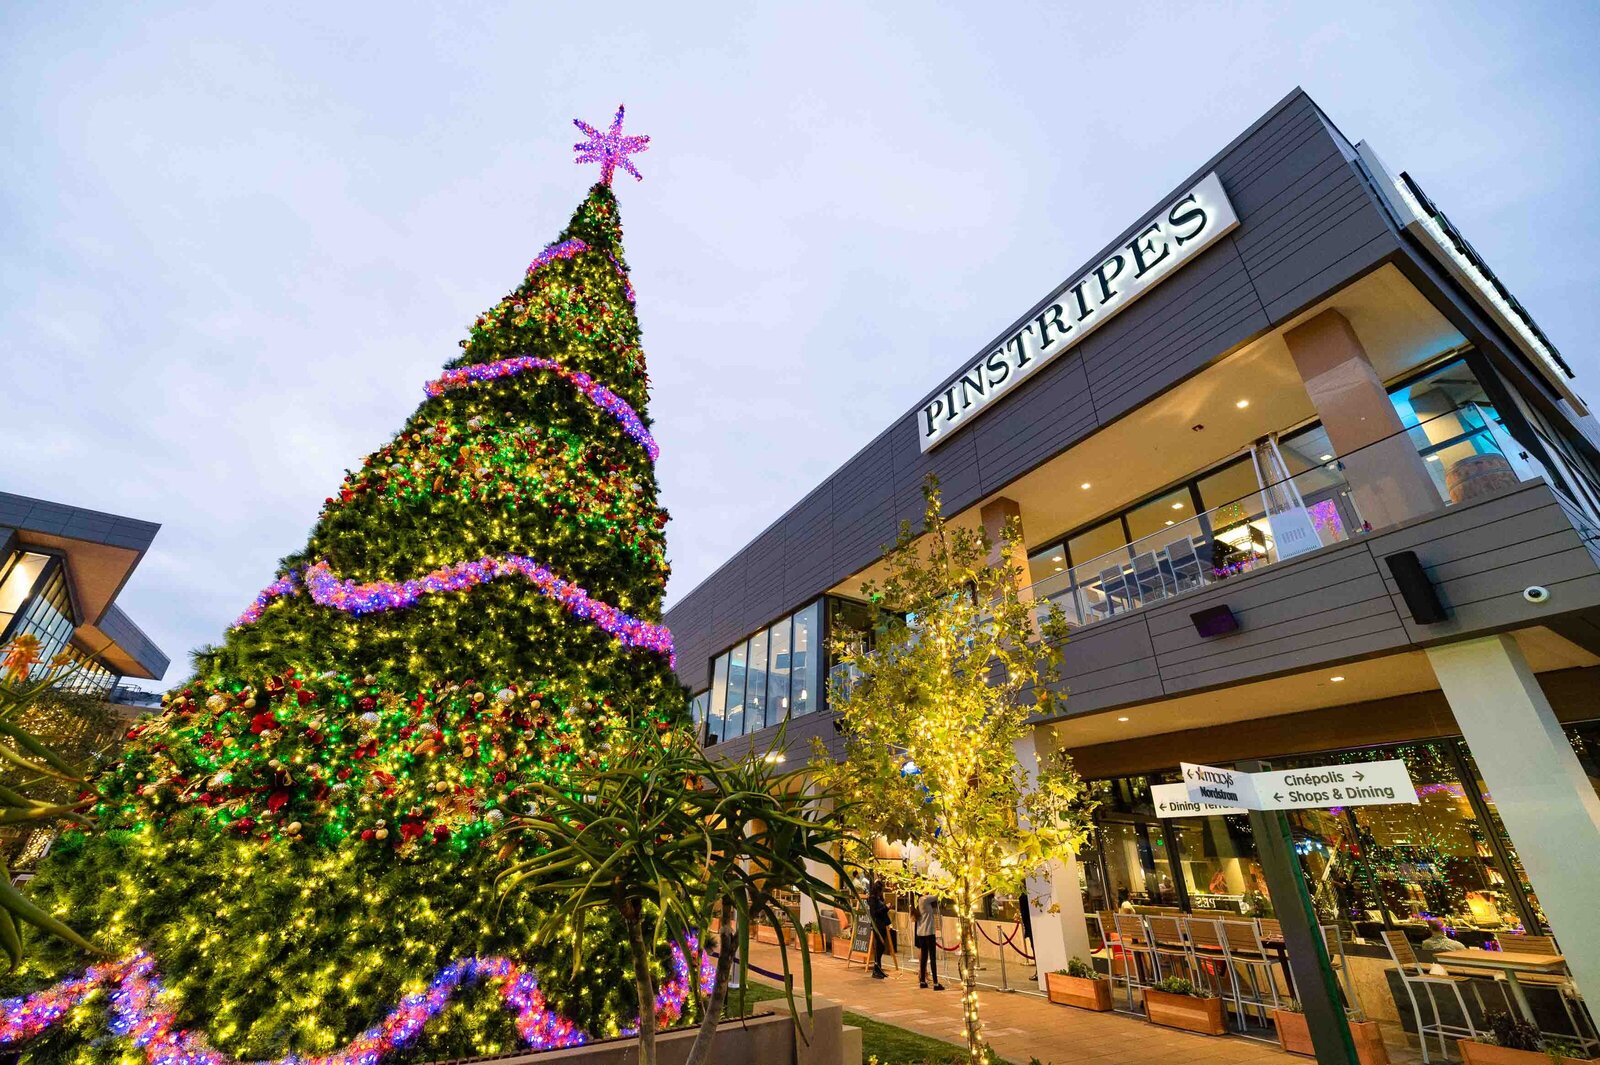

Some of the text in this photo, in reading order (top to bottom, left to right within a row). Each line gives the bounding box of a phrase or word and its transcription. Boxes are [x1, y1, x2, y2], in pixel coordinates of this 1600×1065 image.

[923, 193, 1208, 437] PINSTRIPES
[1284, 771, 1344, 787] Cinépolis
[1200, 786, 1238, 801] Nordstrom
[1288, 785, 1395, 803] Shops & Dining
[1169, 801, 1200, 812] Dining
